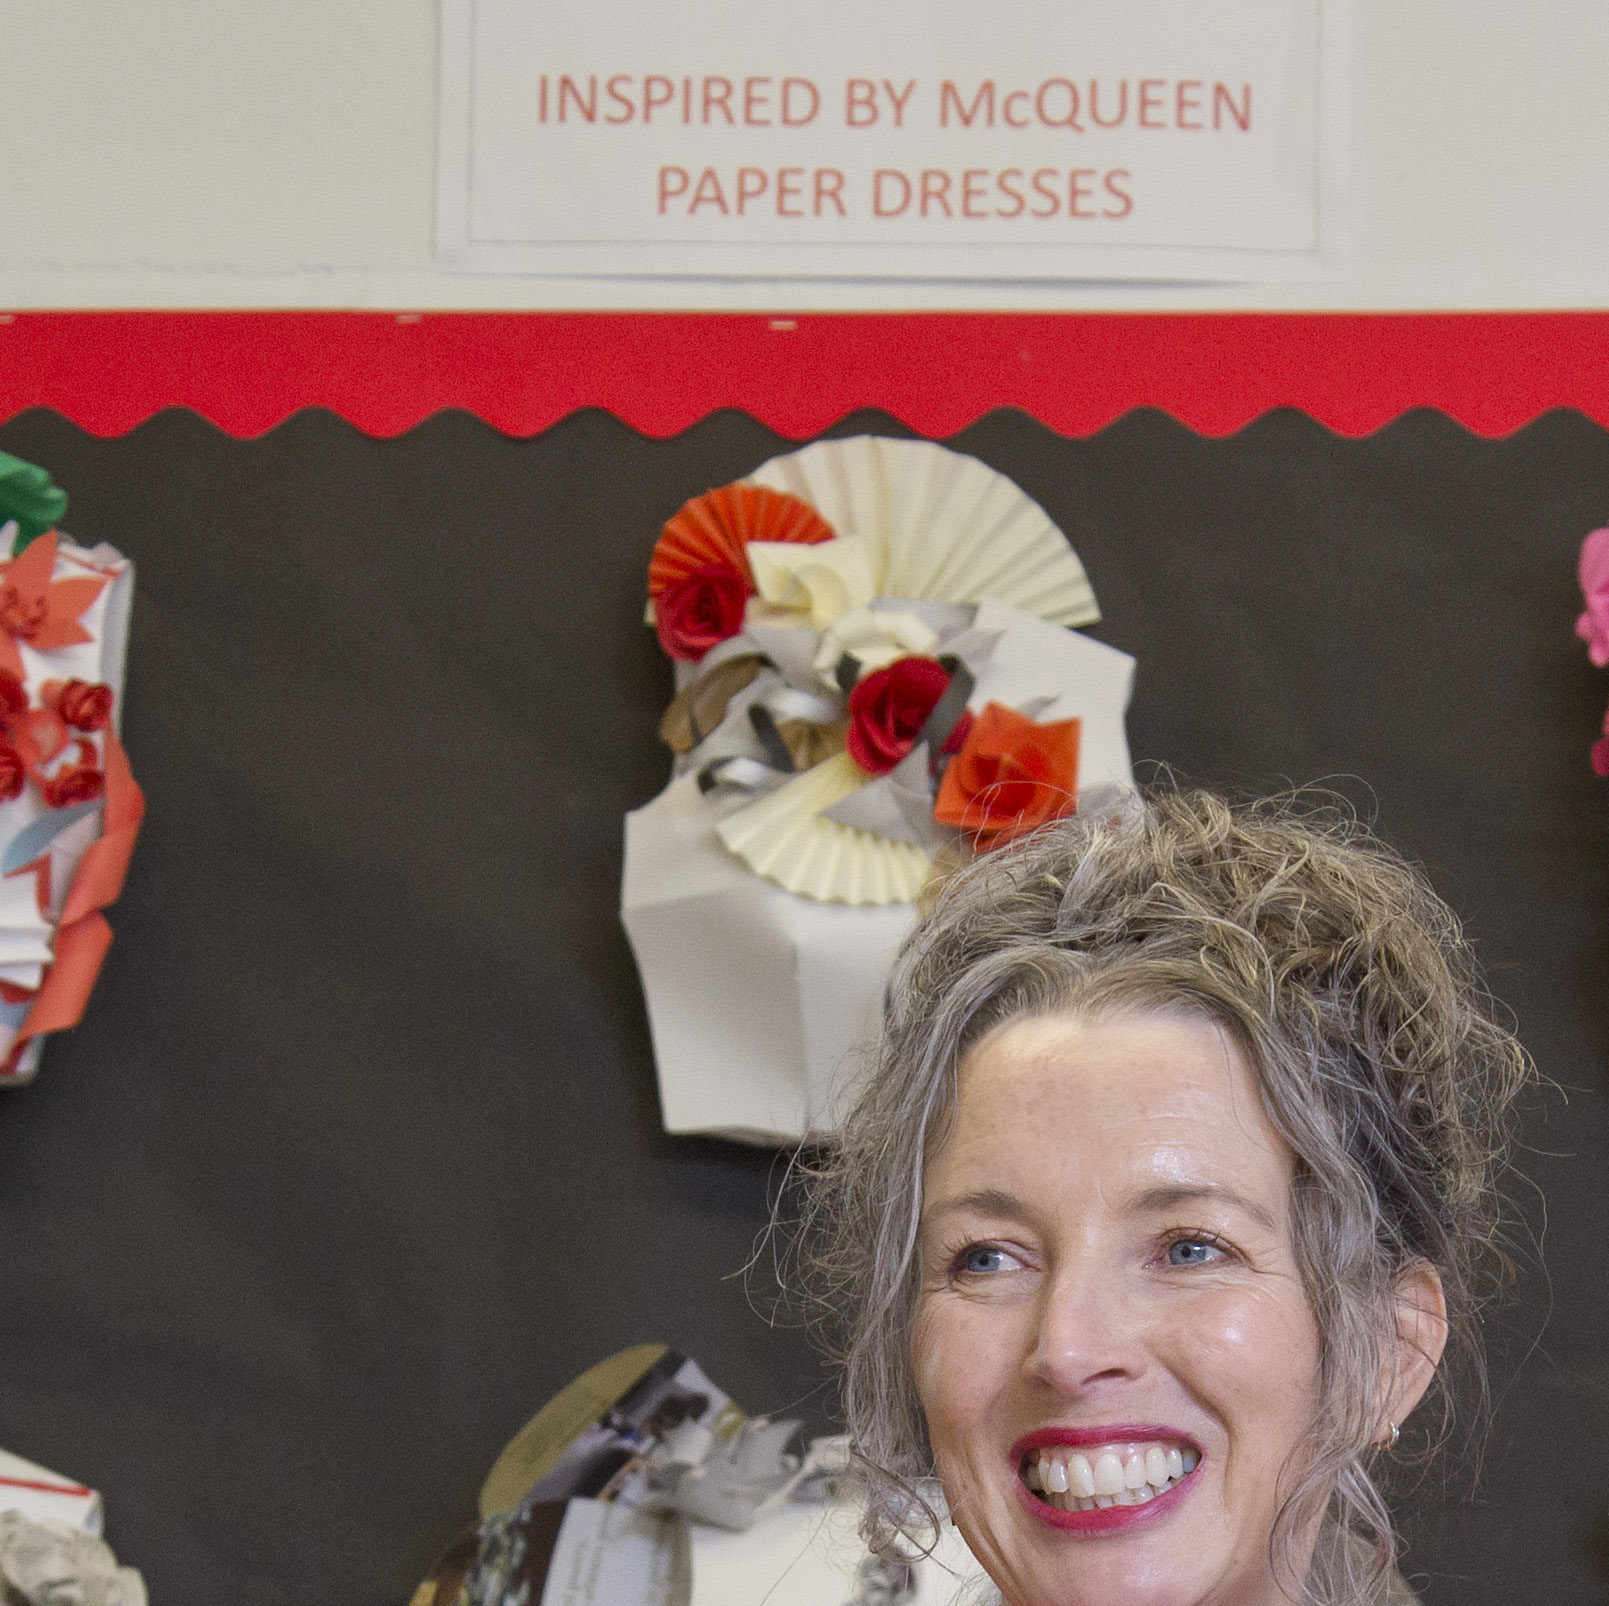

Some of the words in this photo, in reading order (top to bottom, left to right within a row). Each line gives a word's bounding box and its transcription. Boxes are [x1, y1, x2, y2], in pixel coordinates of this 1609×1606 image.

[538, 74, 821, 126] INSPIRED
[845, 77, 917, 128] BY
[939, 77, 1252, 133] McQUEEN
[657, 165, 847, 218] PAPER
[872, 167, 1134, 219] DRESSES
